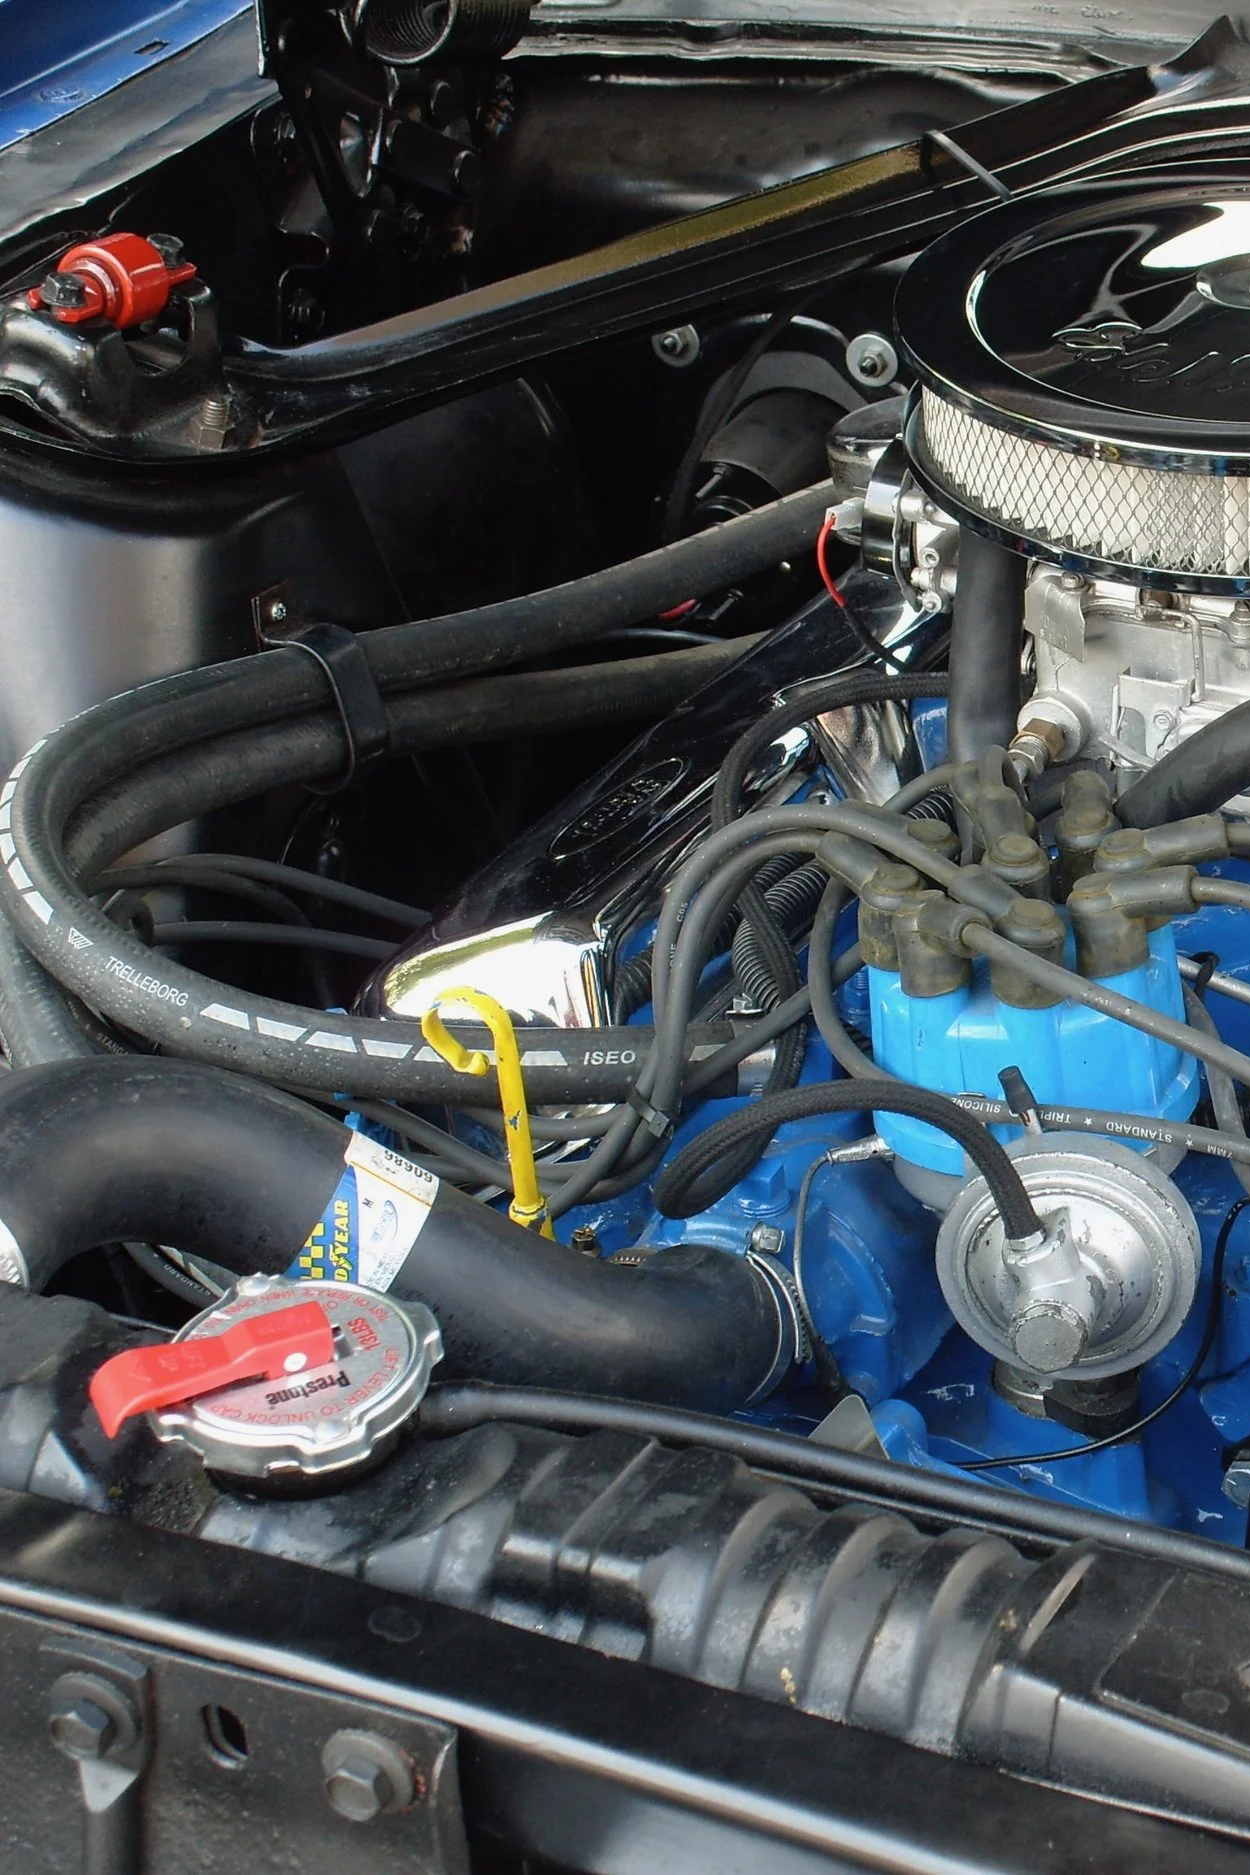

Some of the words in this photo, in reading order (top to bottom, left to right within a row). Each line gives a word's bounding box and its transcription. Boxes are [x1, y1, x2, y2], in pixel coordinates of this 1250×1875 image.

[105, 955, 190, 1008] TRELLEBORG
[582, 1048, 636, 1067] ISEO
[1105, 1121, 1174, 1144] STANDARD
[332, 1199, 350, 1283] DYEAR
[368, 1304, 391, 1323] TEST
[346, 1316, 382, 1353] 13LBS
[265, 1370, 352, 1407] Prestone
[347, 1369, 390, 1406] LEVER
[246, 1408, 318, 1425] UNLOCK
[320, 1404, 344, 1416] TO
